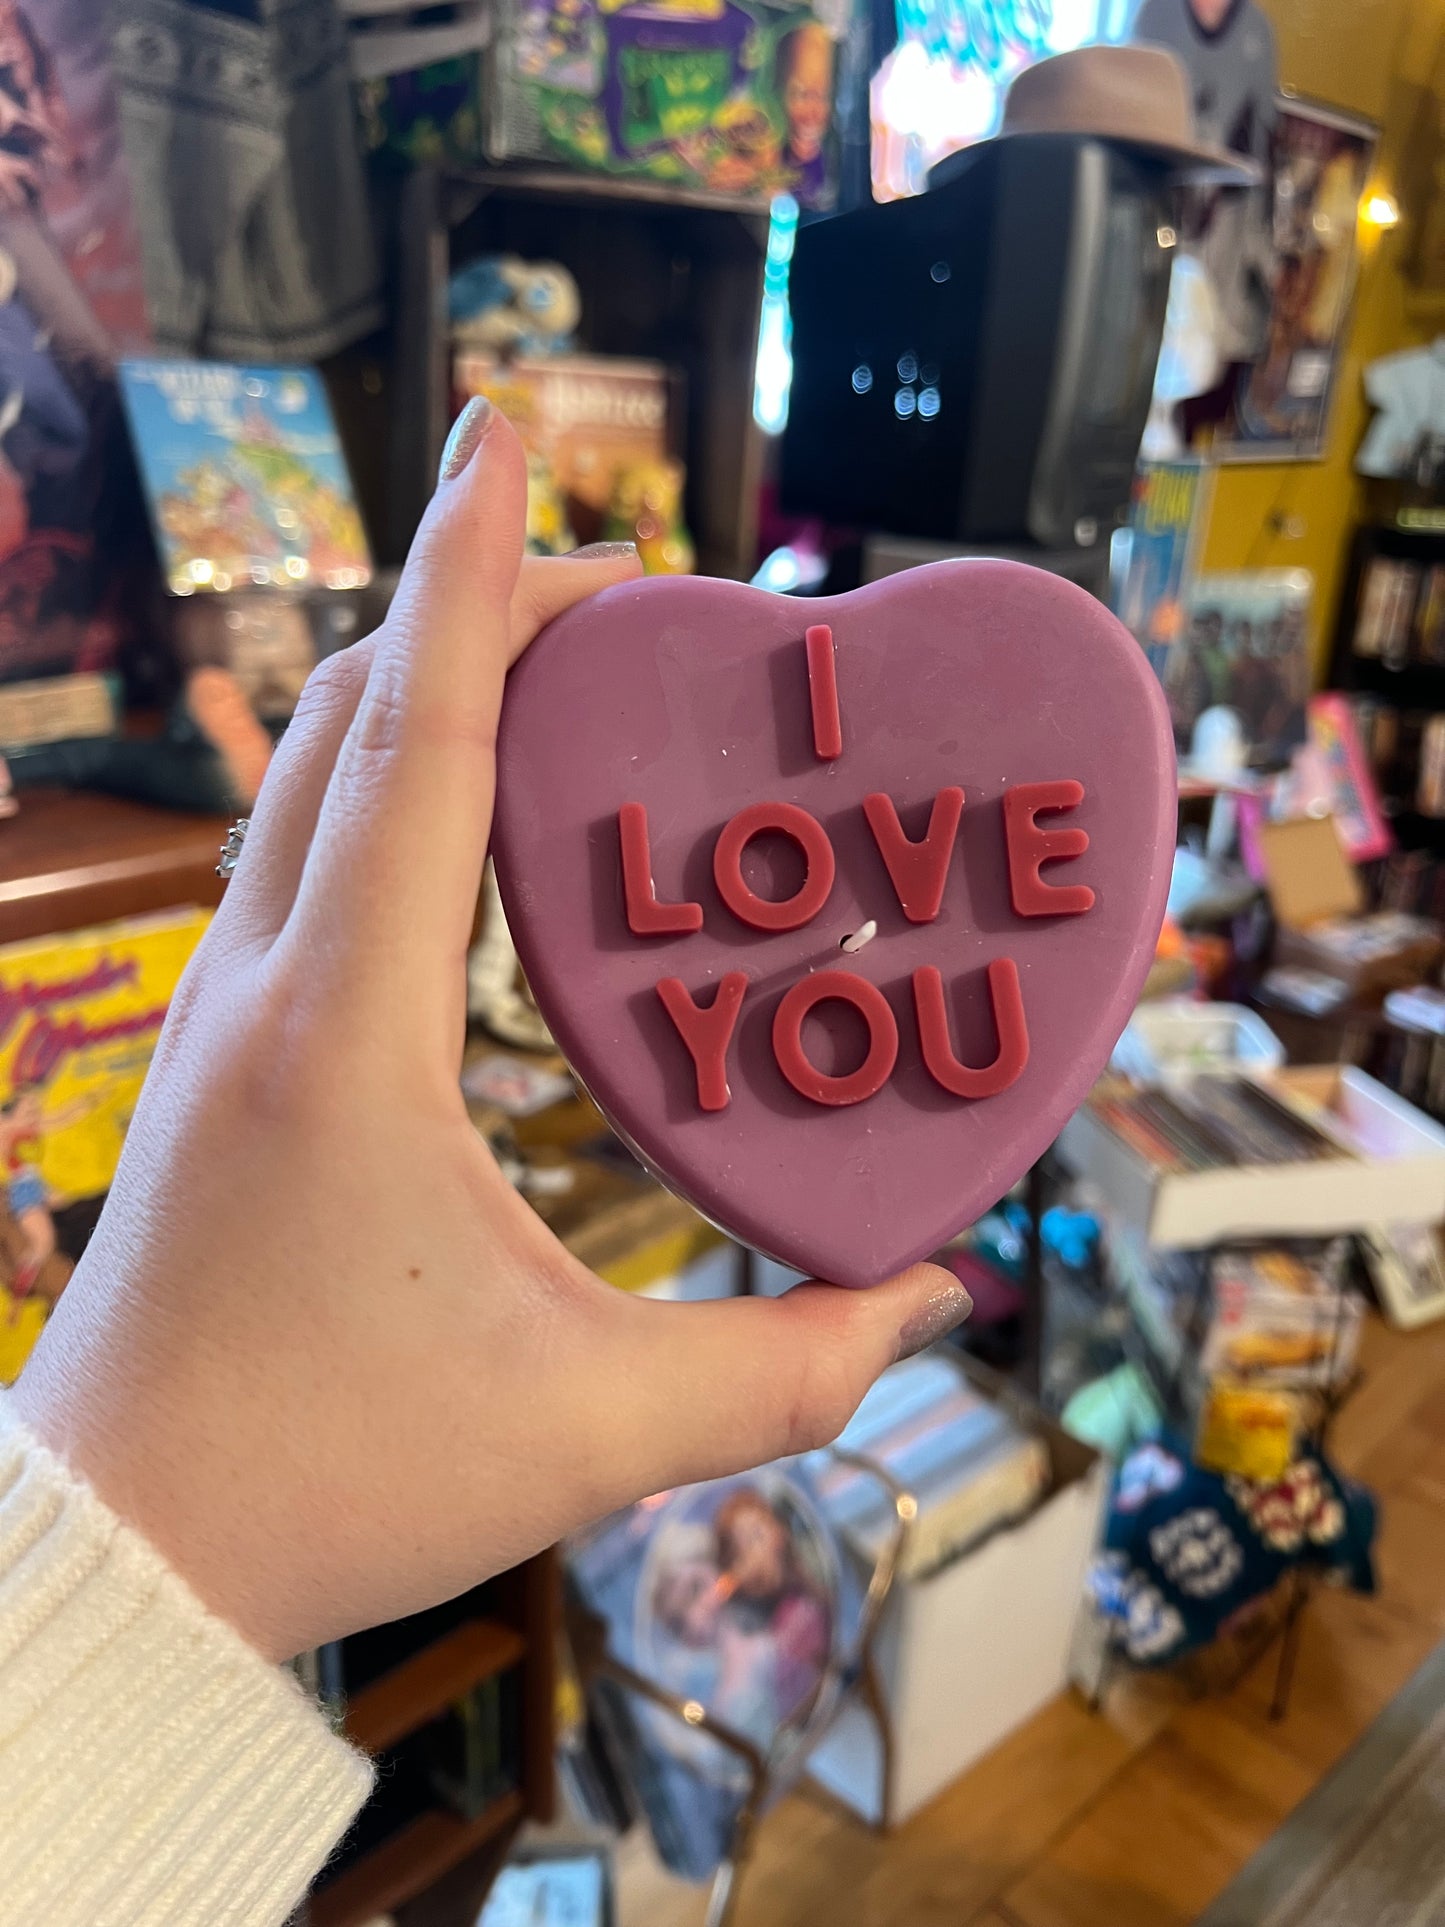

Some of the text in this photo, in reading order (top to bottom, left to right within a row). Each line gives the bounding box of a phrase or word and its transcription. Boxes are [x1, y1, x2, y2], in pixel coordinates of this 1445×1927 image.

[805, 624, 843, 760] I
[618, 779, 1096, 934] LOVE
[655, 957, 1030, 1111] YOU
